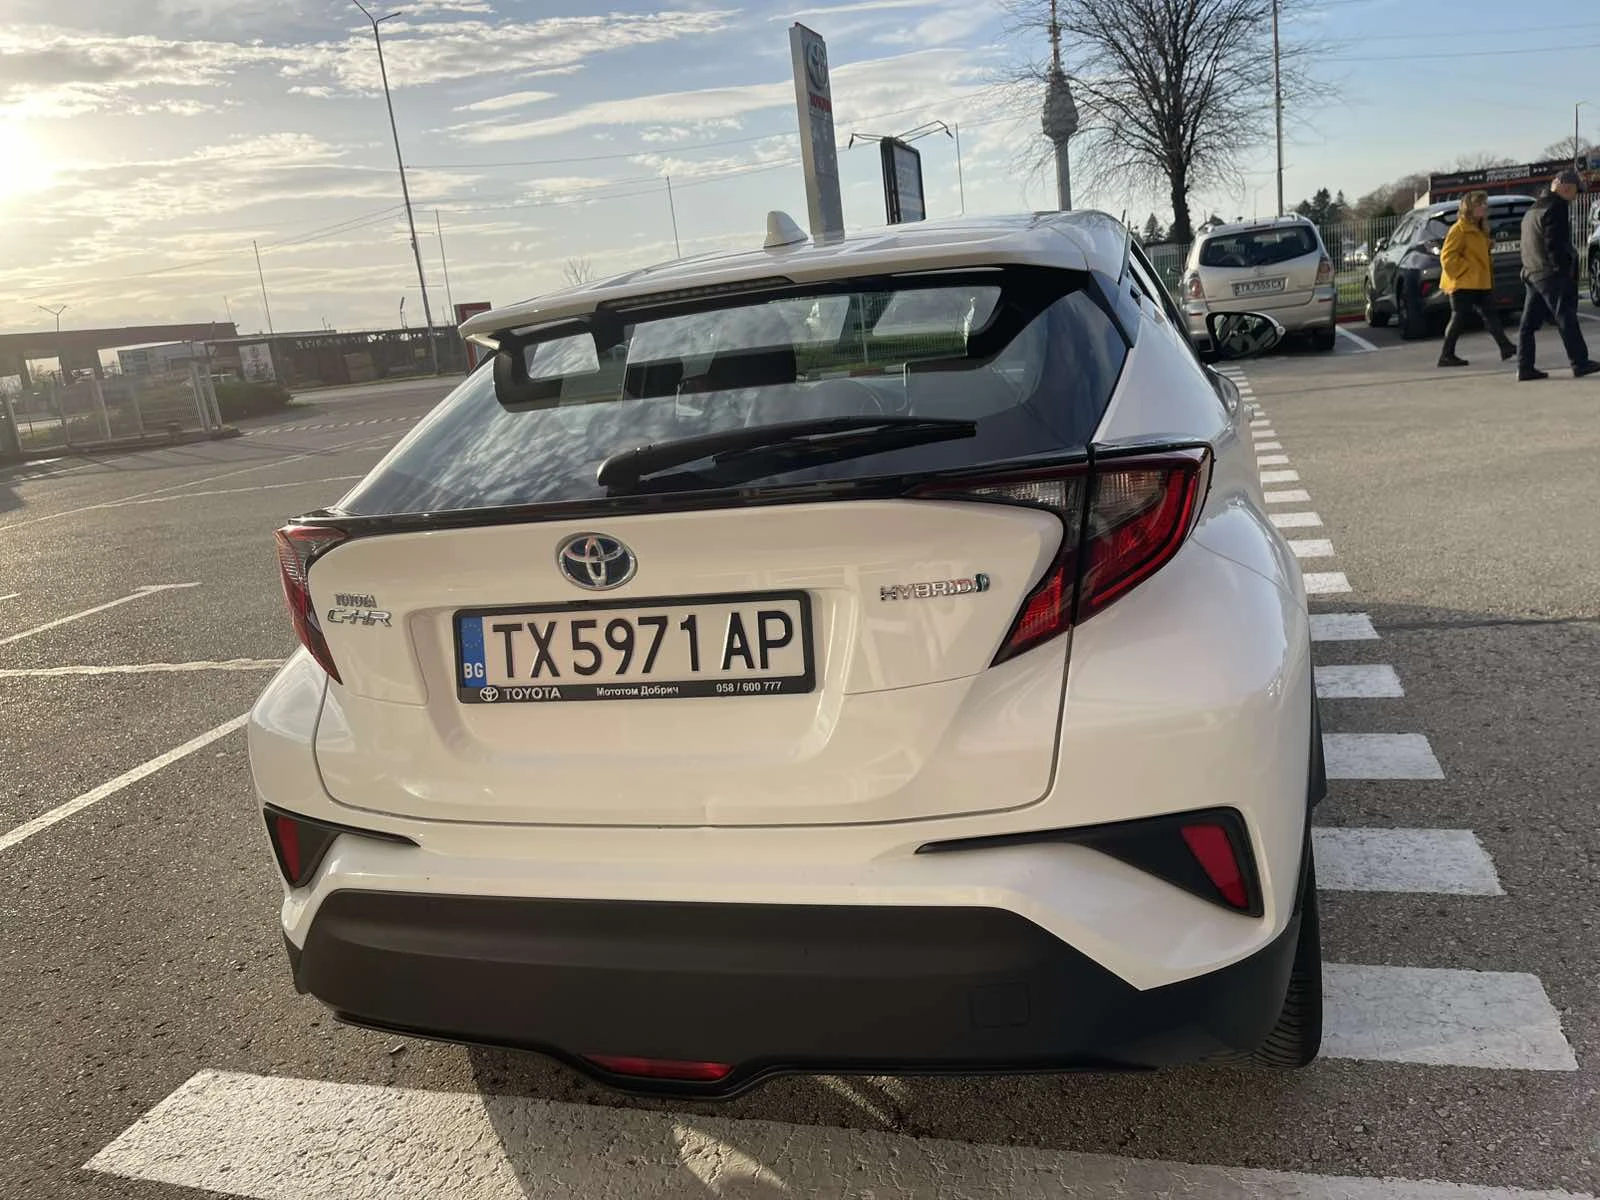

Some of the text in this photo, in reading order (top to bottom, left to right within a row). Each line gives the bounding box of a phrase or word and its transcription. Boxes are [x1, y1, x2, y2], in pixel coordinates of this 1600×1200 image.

[880, 578, 972, 601] HYBRID
[335, 593, 377, 608] TOYOTA
[463, 662, 485, 679] BG
[504, 687, 562, 701] TOYOTA
[596, 684, 680, 698] Мототом Добрич
[715, 683, 735, 694] 058
[742, 681, 762, 693] 600
[763, 681, 782, 692] 777
